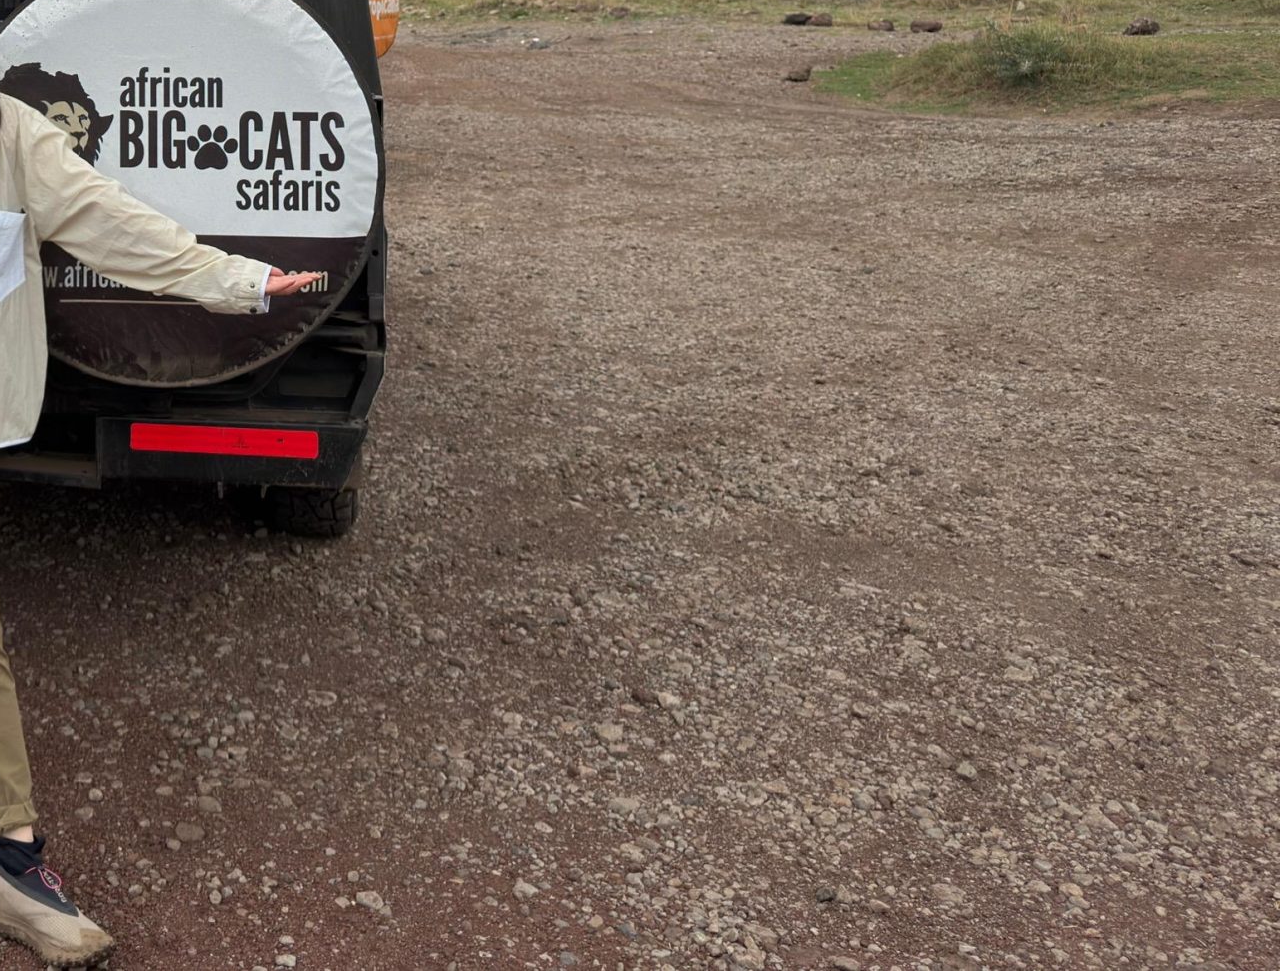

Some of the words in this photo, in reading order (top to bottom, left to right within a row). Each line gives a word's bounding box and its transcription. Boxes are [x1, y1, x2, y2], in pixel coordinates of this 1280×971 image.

[120, 67, 223, 108] african
[120, 110, 187, 169] BIG
[239, 111, 346, 171] CATS
[235, 170, 341, 213] safaris
